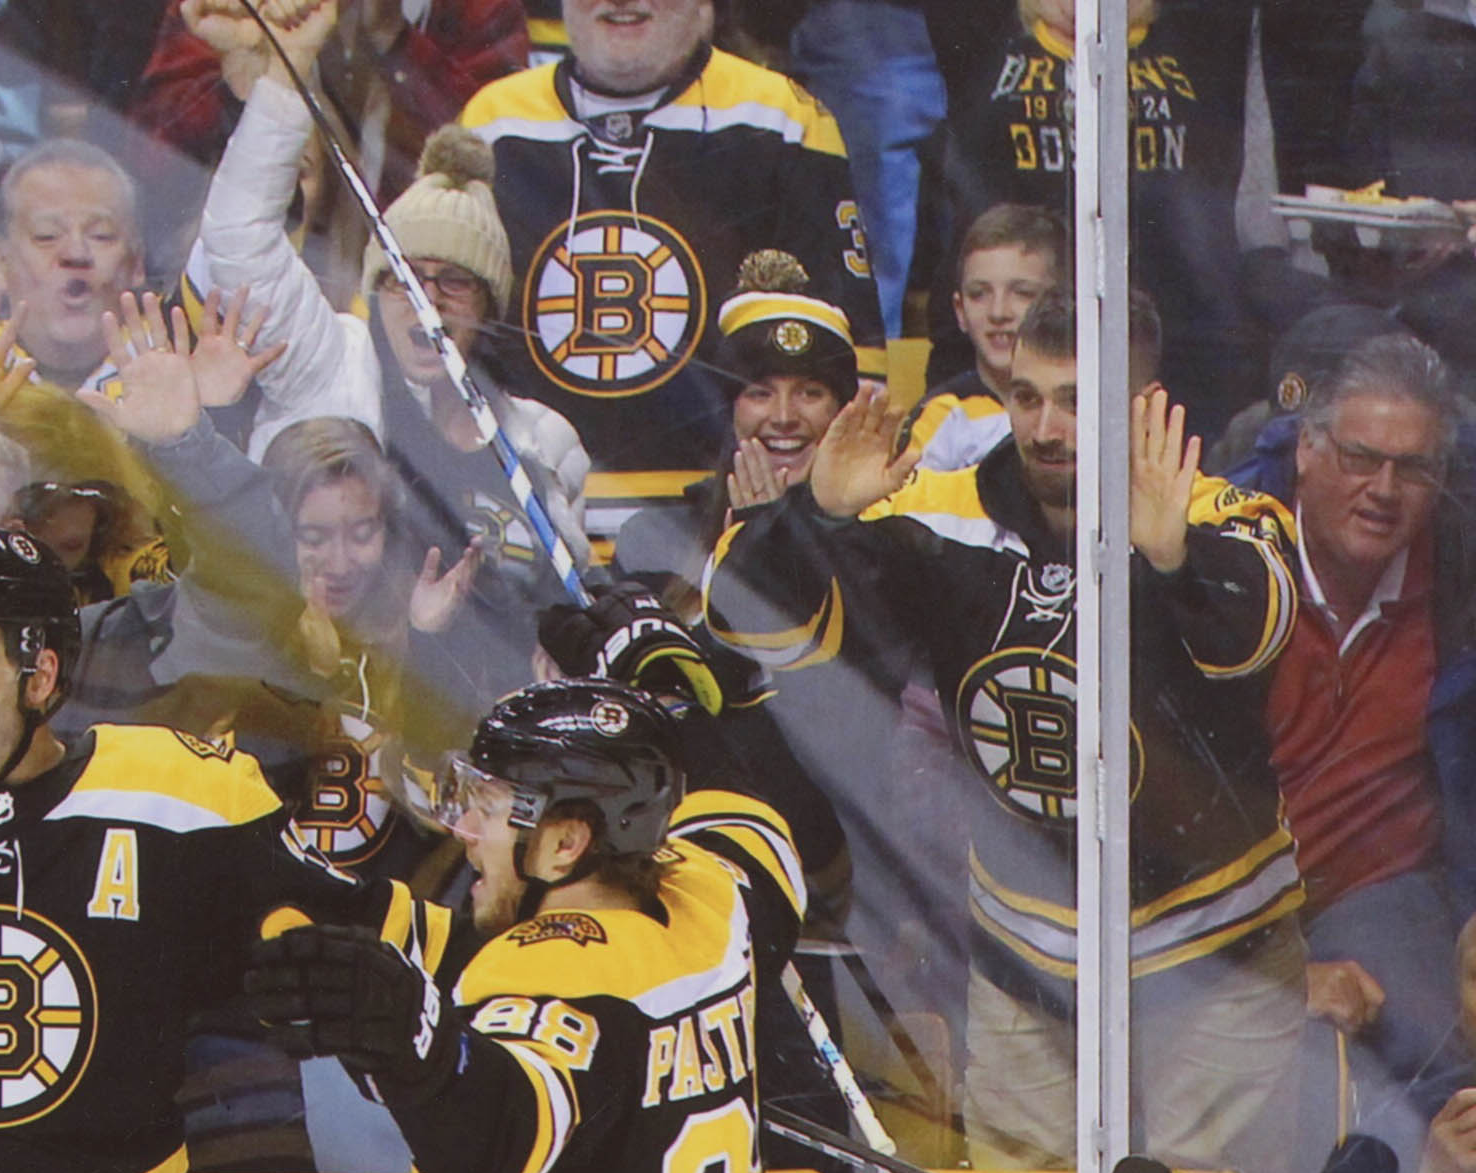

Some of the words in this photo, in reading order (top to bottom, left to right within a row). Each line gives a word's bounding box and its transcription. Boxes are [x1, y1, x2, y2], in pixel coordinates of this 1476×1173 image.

[1024, 95, 1048, 120] 19
[1141, 96, 1172, 120] 24
[87, 828, 141, 921] A
[469, 997, 600, 1071] 88
